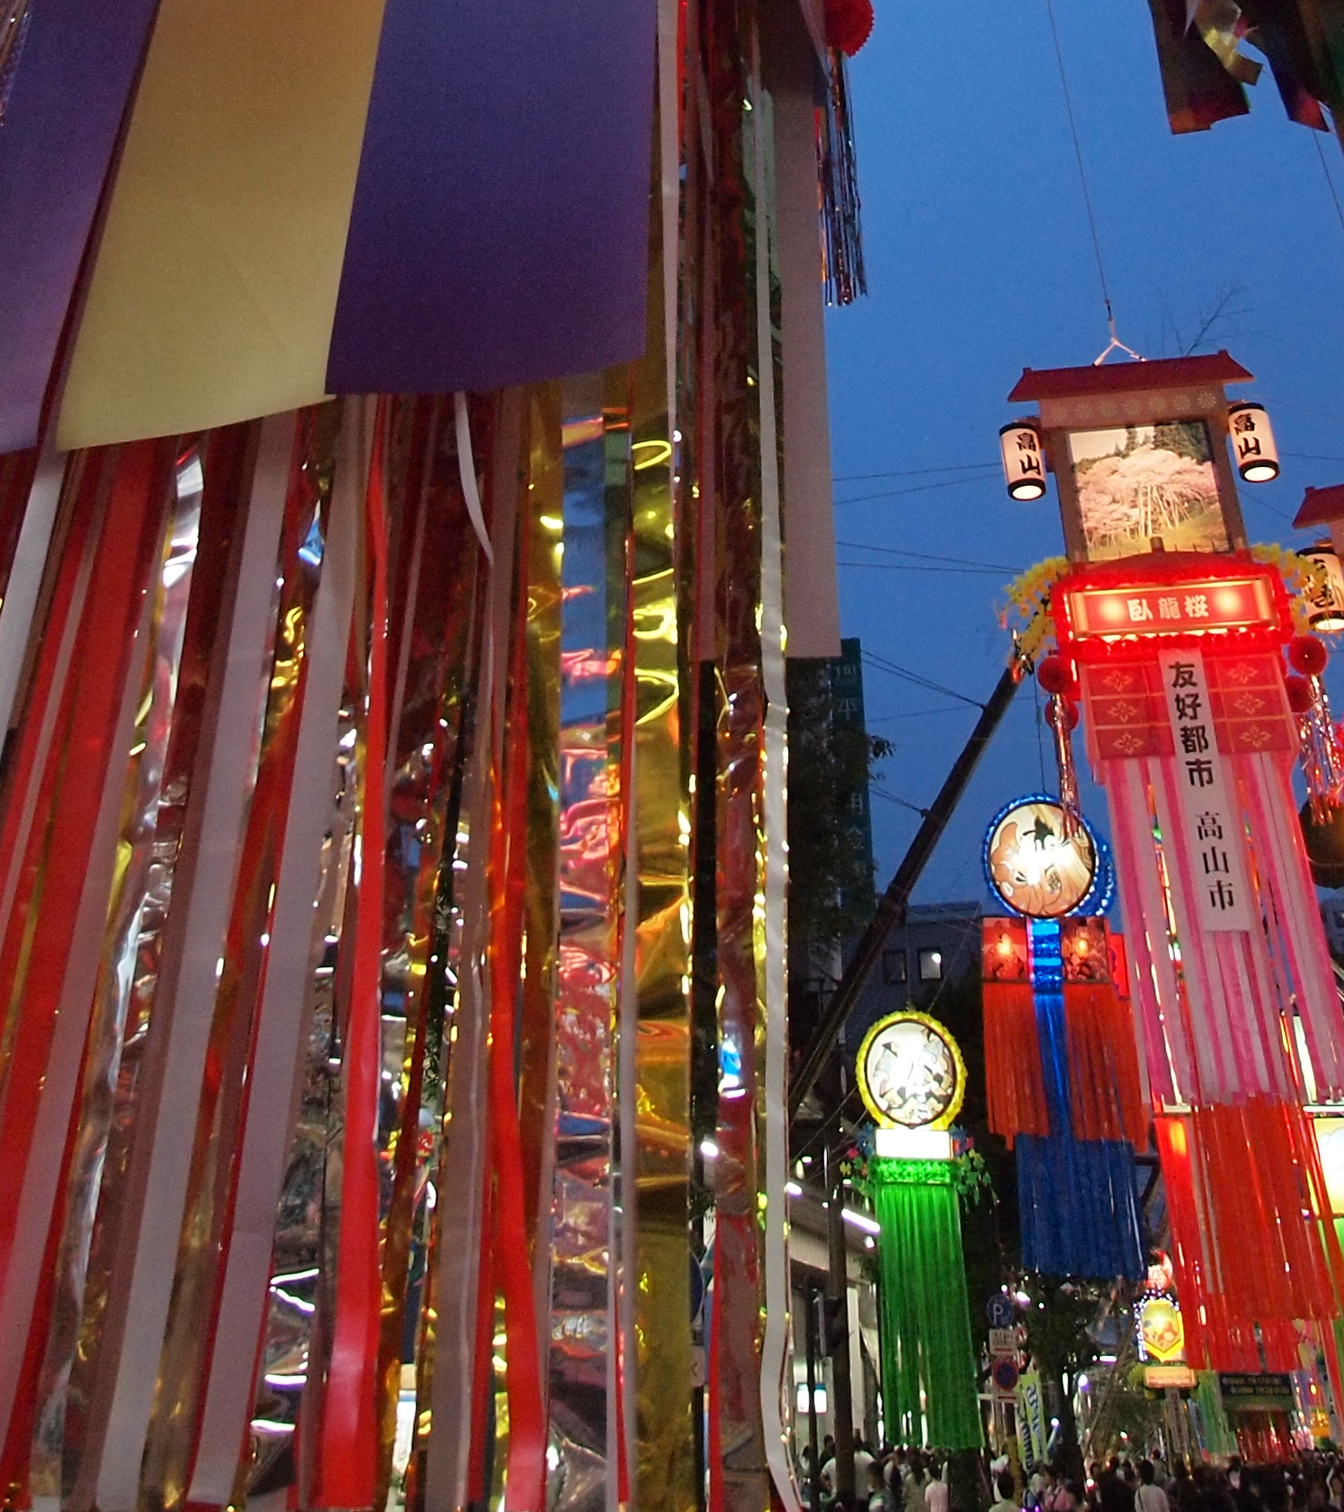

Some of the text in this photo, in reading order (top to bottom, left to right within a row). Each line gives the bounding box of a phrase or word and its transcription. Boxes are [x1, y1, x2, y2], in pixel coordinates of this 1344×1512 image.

[1167, 659, 1236, 911] 友好都市 高山市
